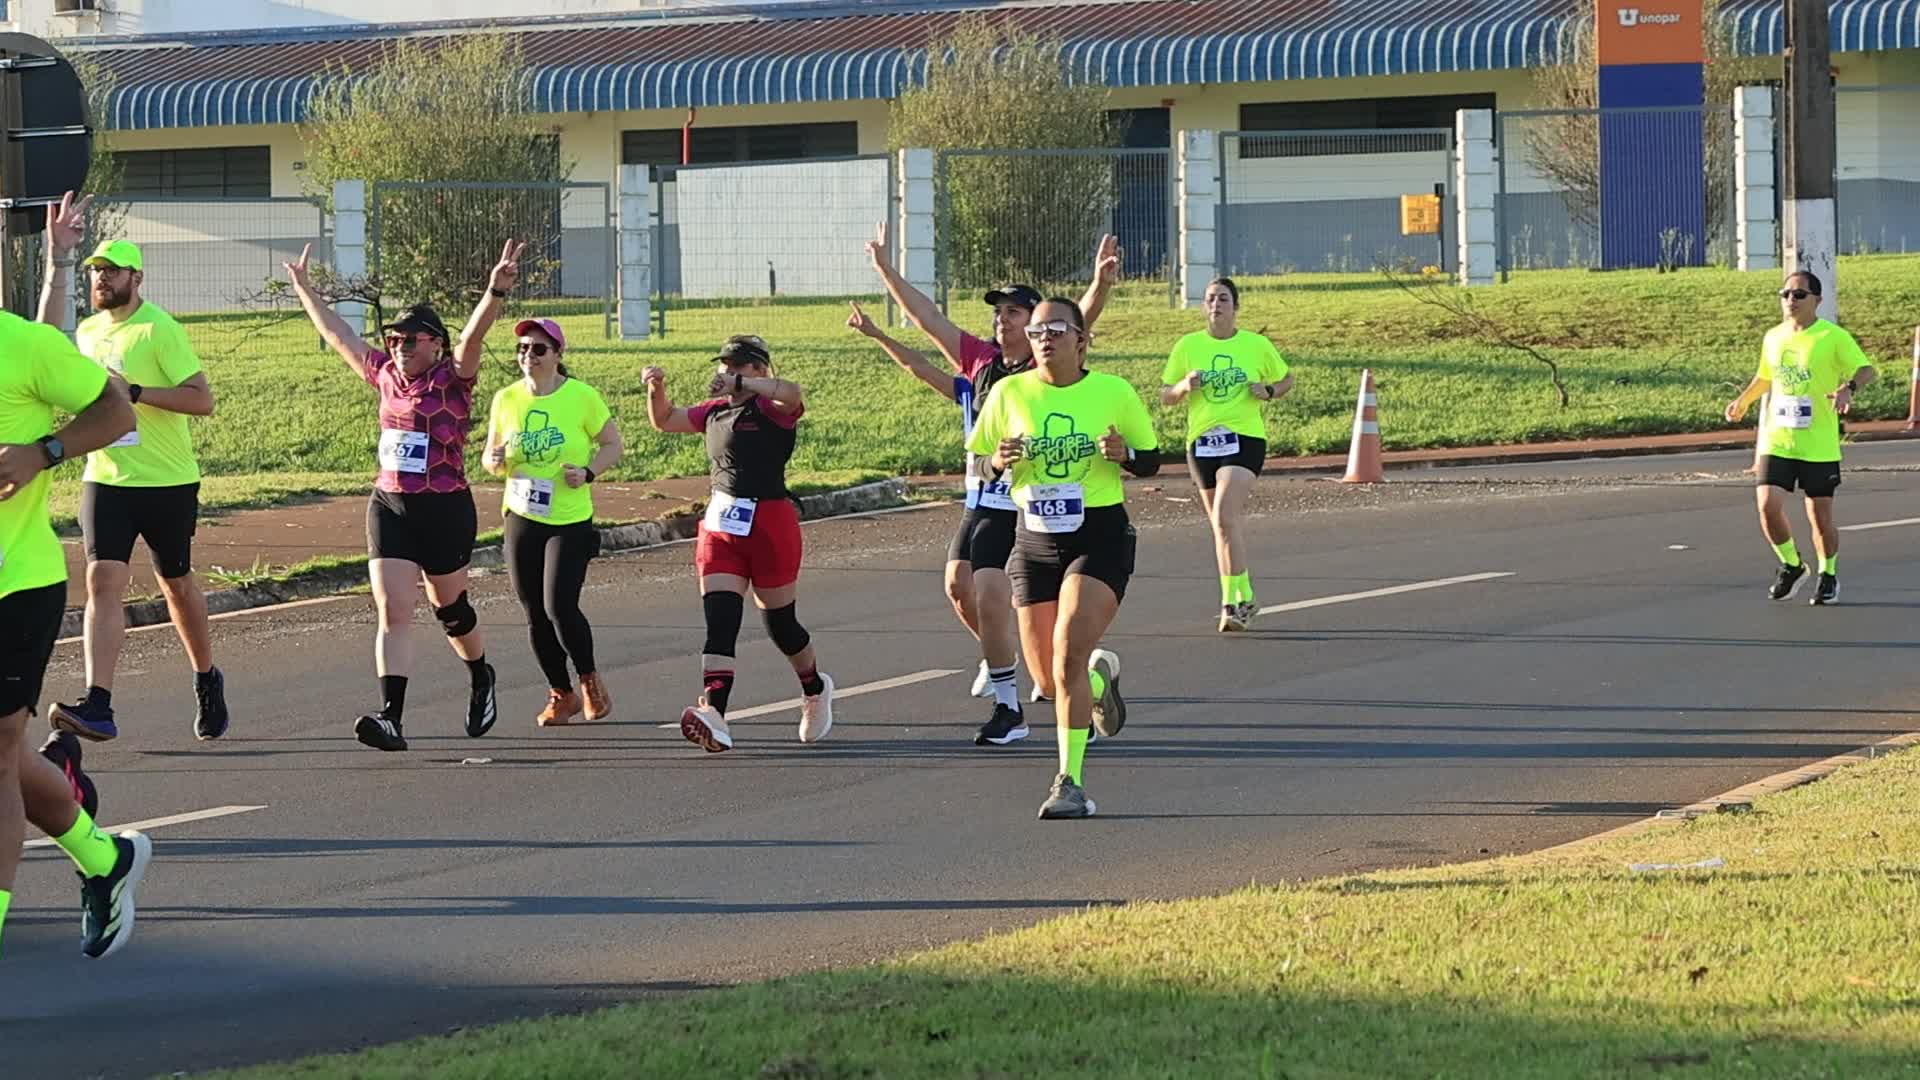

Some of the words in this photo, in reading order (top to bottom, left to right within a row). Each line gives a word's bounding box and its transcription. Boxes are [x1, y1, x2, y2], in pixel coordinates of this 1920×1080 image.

[1640, 14, 1681, 25] unopar
[1206, 435, 1227, 446] 213
[1046, 445, 1079, 465] RUN
[1034, 500, 1067, 516] 168
